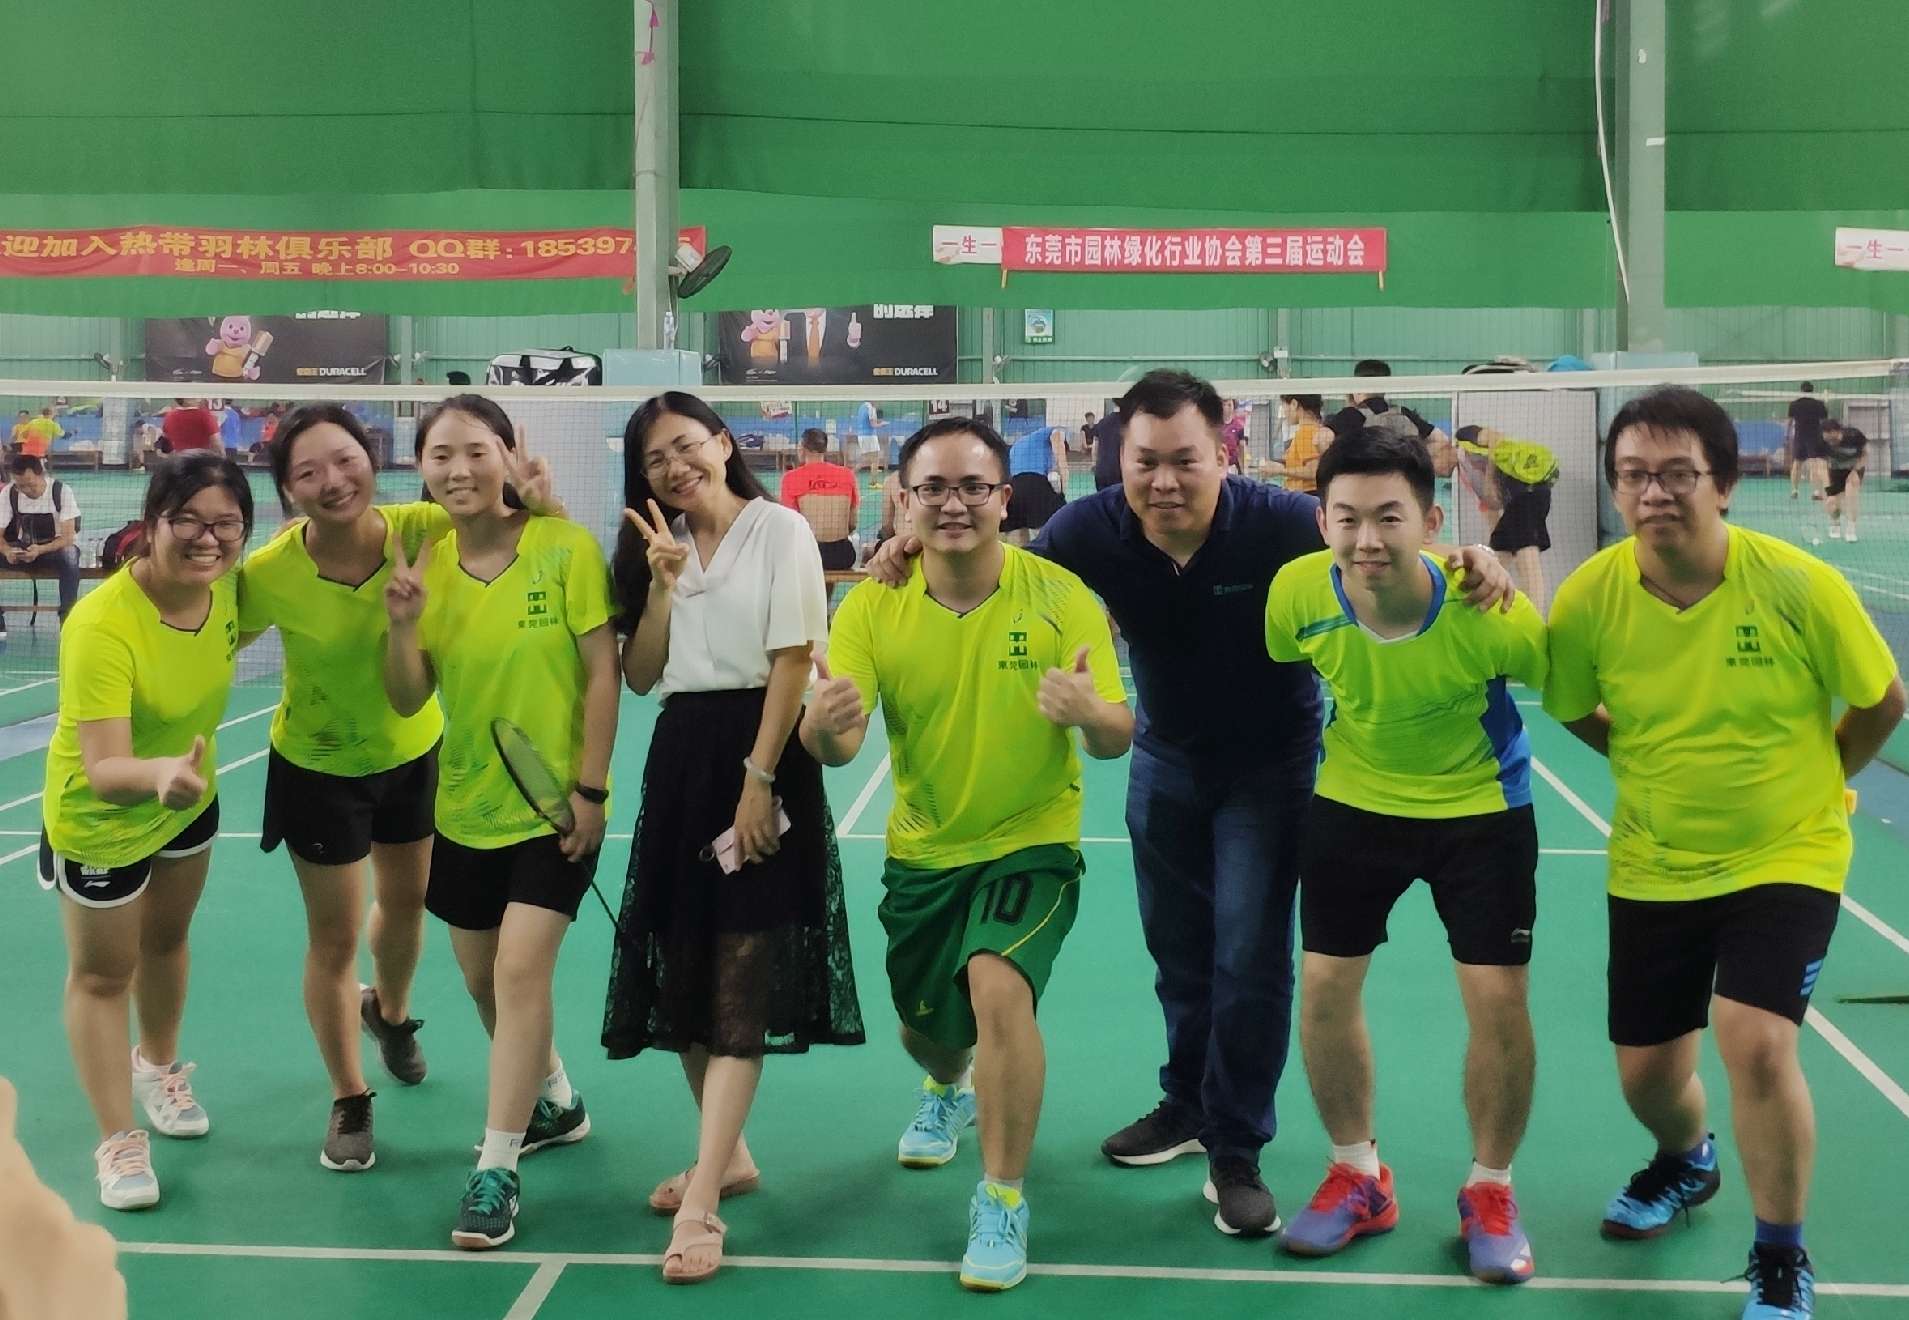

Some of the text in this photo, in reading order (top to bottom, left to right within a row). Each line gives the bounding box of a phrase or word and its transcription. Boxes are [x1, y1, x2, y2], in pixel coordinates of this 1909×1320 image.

[1024, 234, 1365, 267] 东莞市园林绿化行业协会第三届运动会
[319, 367, 367, 377] DURACELL
[894, 367, 938, 376] DURACELL
[980, 867, 1034, 926] 10
